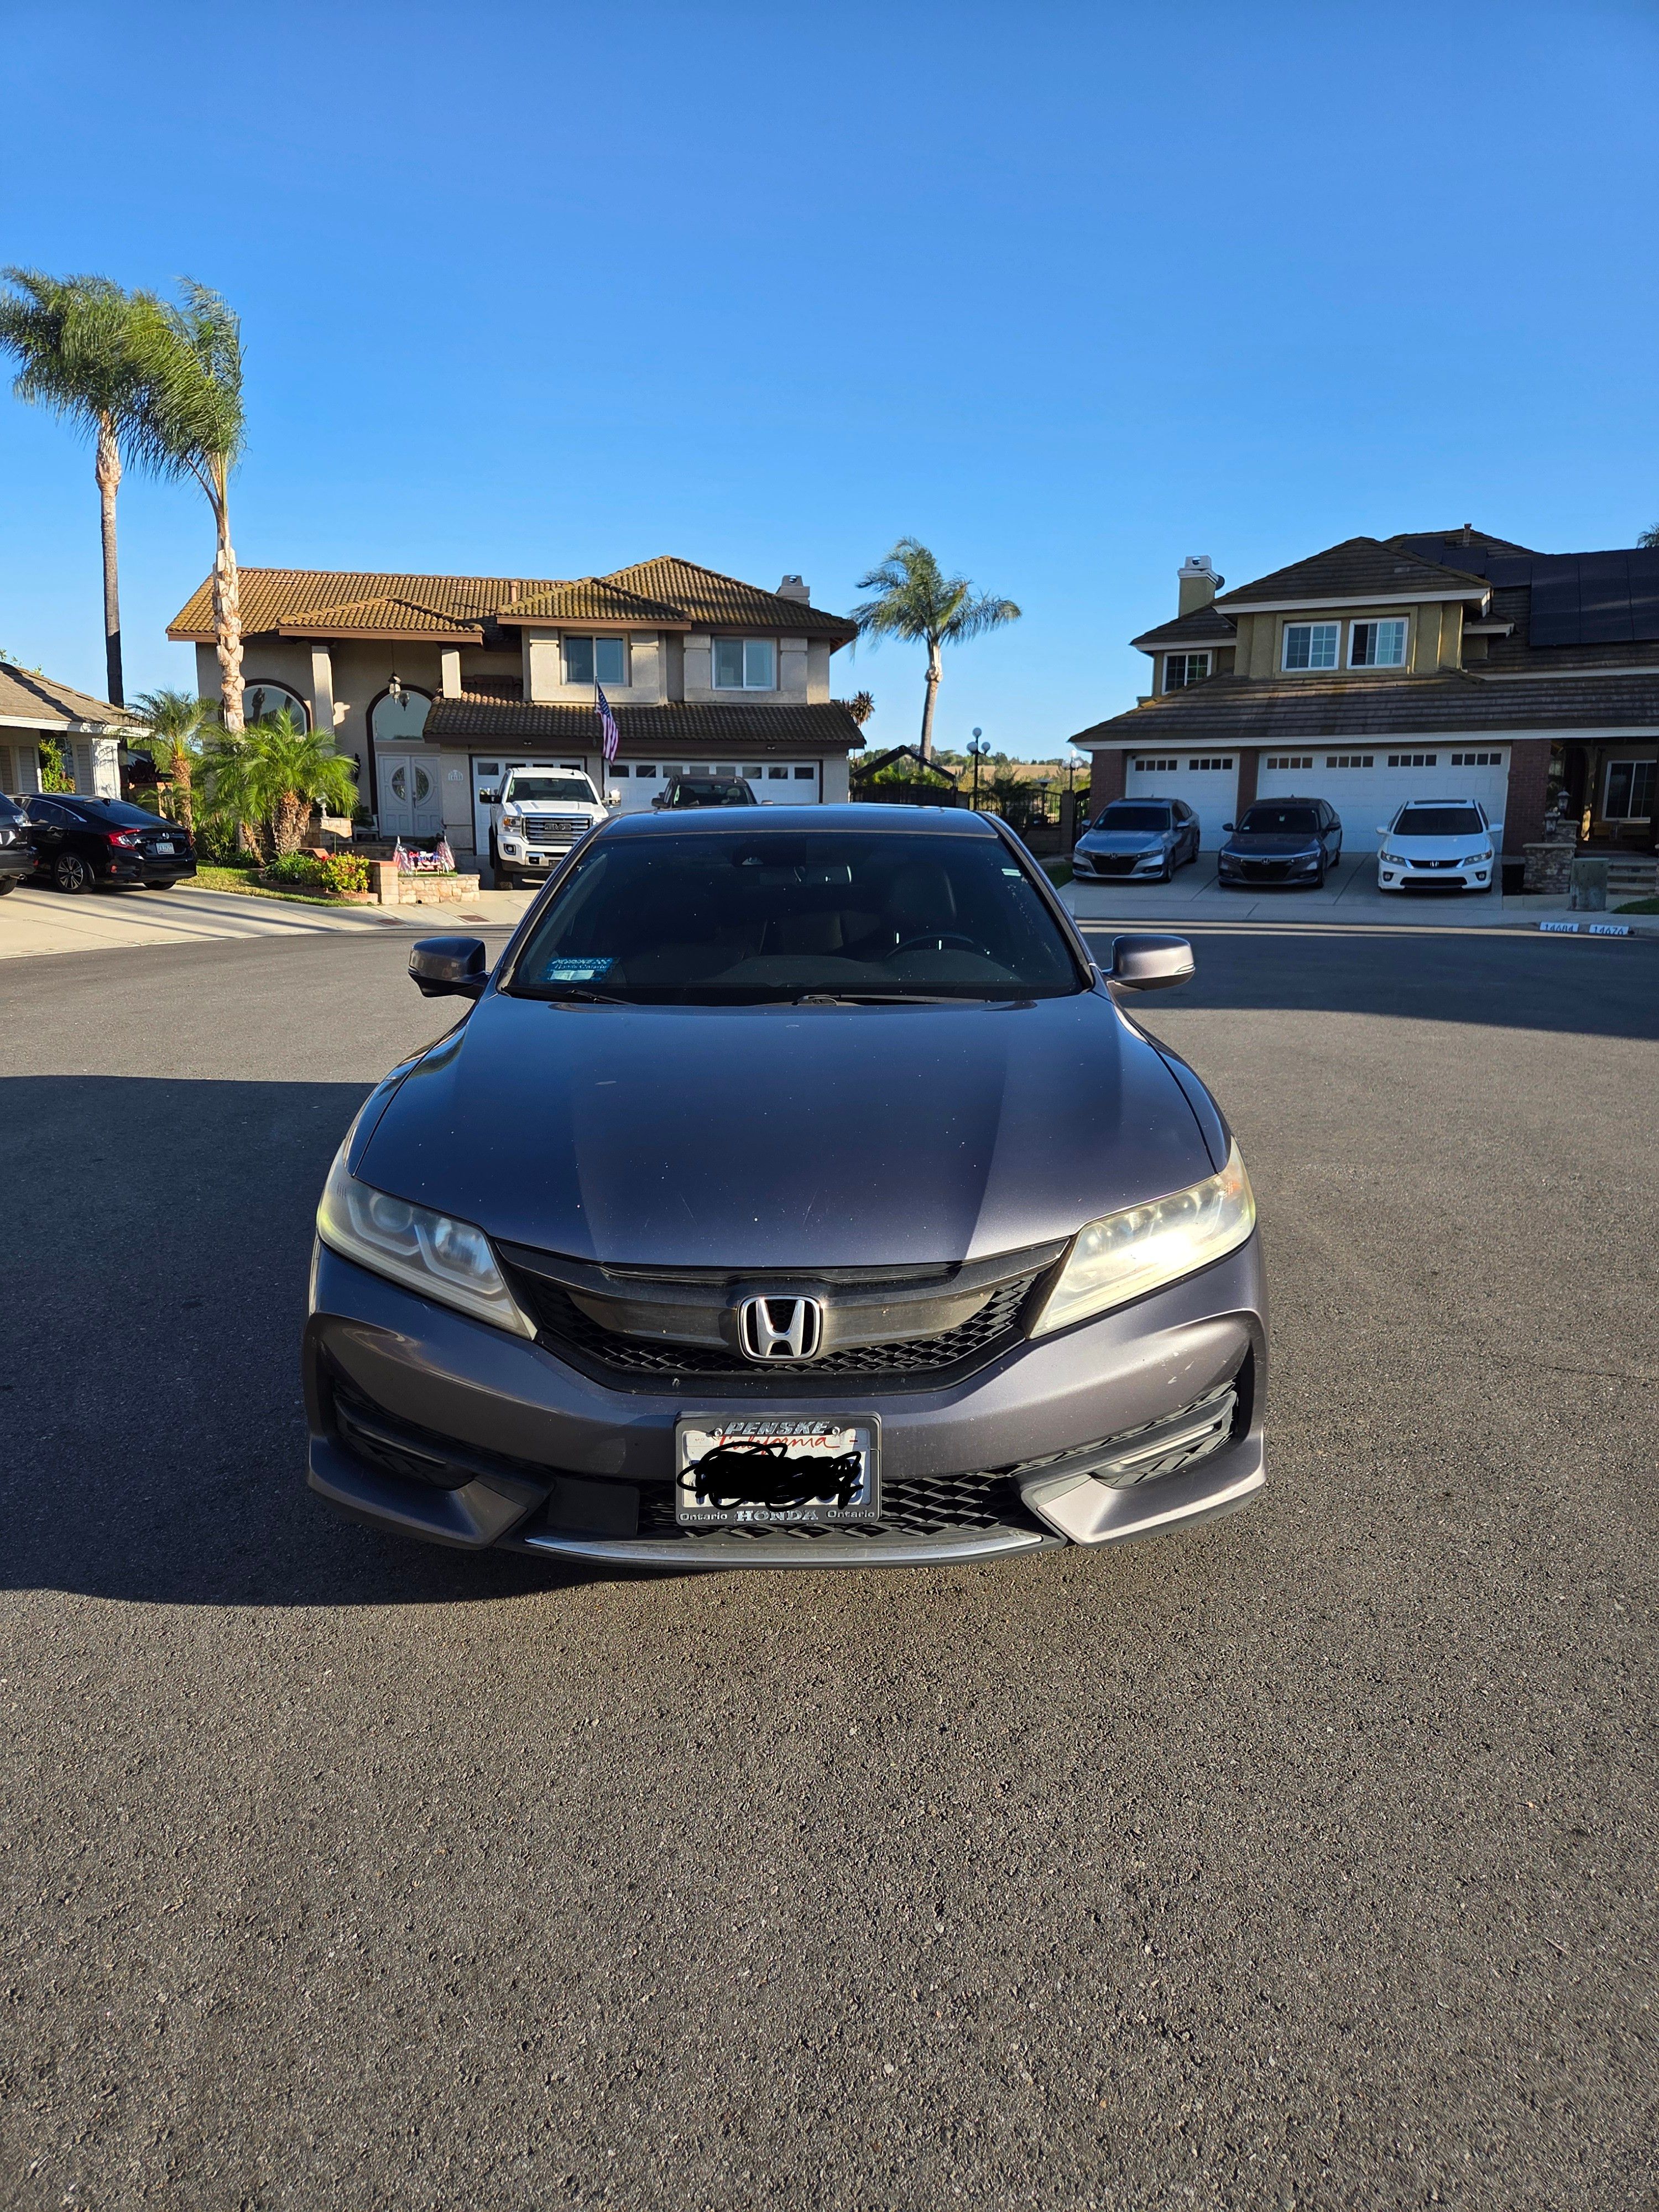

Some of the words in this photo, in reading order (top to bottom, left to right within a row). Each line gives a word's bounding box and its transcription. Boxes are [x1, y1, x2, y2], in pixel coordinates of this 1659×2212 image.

[724, 1421, 830, 1435] PENSKE
[679, 1512, 728, 1521] Ontario
[735, 1510, 819, 1522] HONDA
[827, 1510, 875, 1519] Ontario
